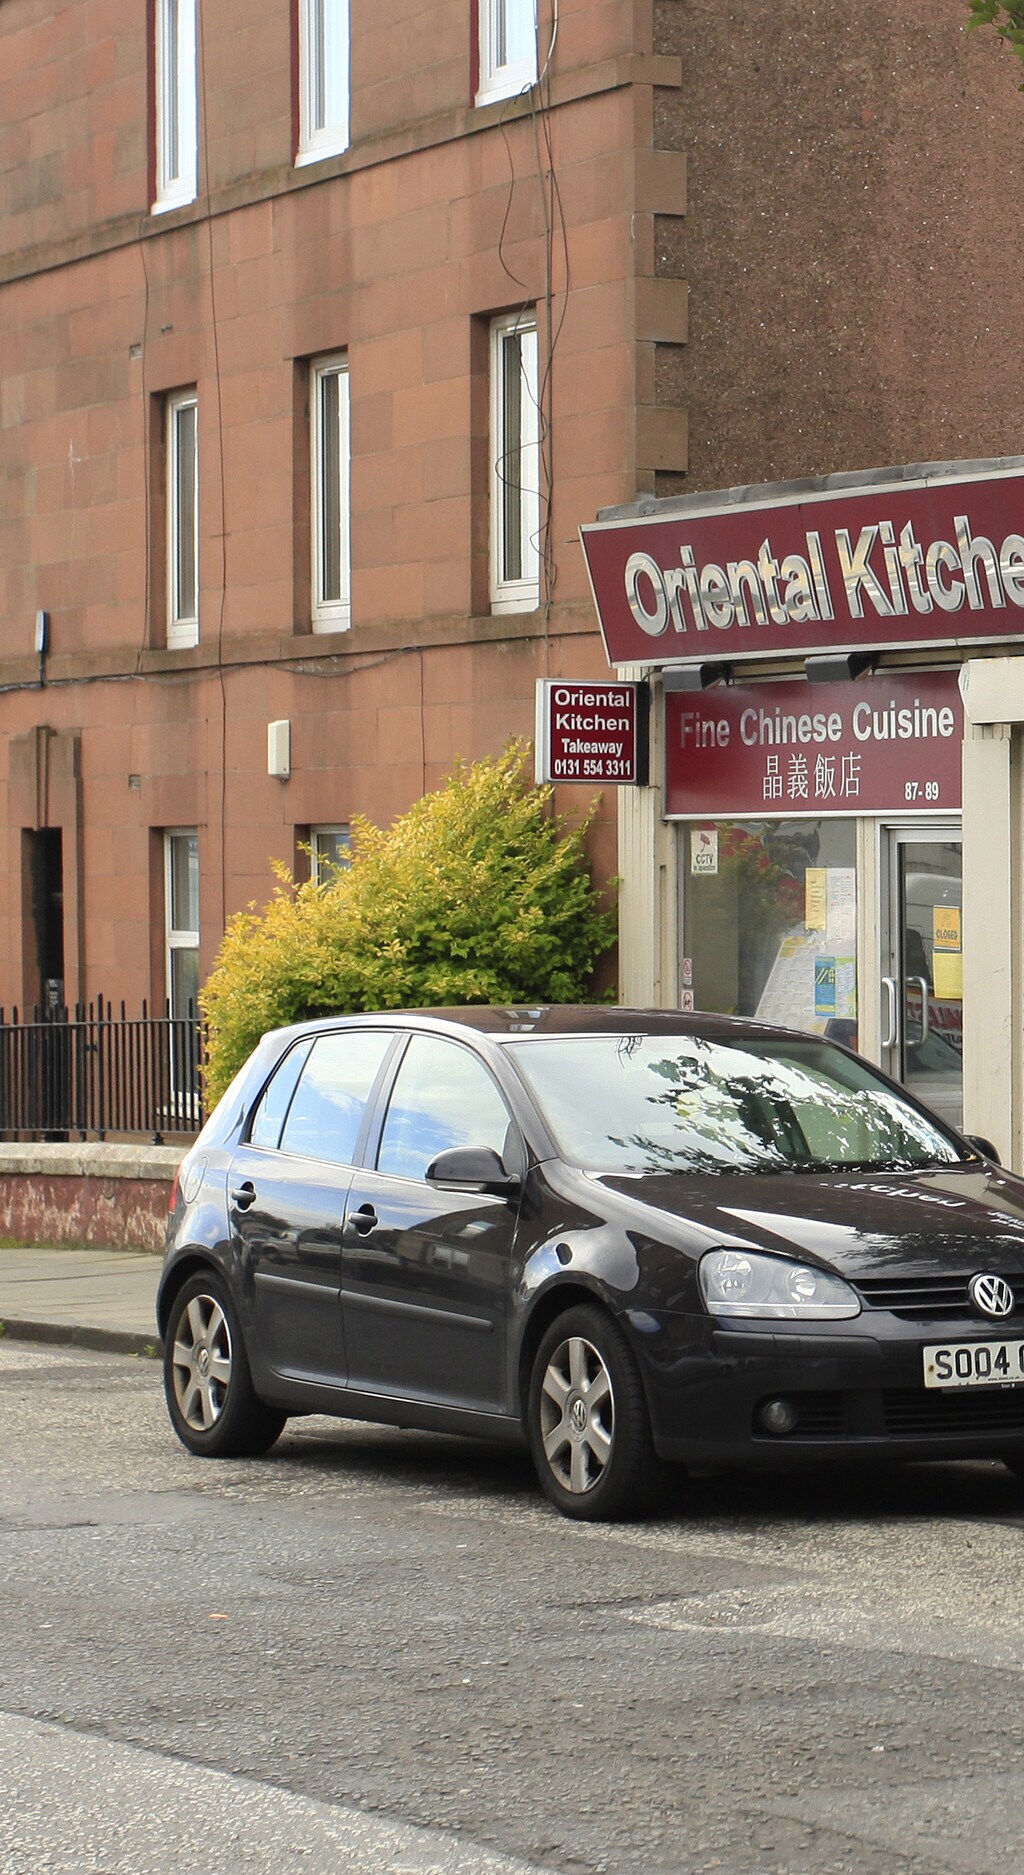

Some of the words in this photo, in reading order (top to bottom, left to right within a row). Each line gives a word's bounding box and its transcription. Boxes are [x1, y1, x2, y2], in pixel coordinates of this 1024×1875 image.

[625, 531, 835, 637] Oriental
[554, 689, 630, 707] Oriental
[555, 713, 630, 731] Kitchen
[680, 711, 730, 748] Fine
[740, 707, 842, 746] Chinese
[852, 699, 954, 741] Cuisine
[561, 738, 624, 758] Takeaway
[554, 759, 580, 775] 0131
[583, 759, 603, 775] 554
[605, 759, 631, 776] 3311
[763, 751, 862, 800] 晶義飯店
[935, 929, 958, 940] CLOSED
